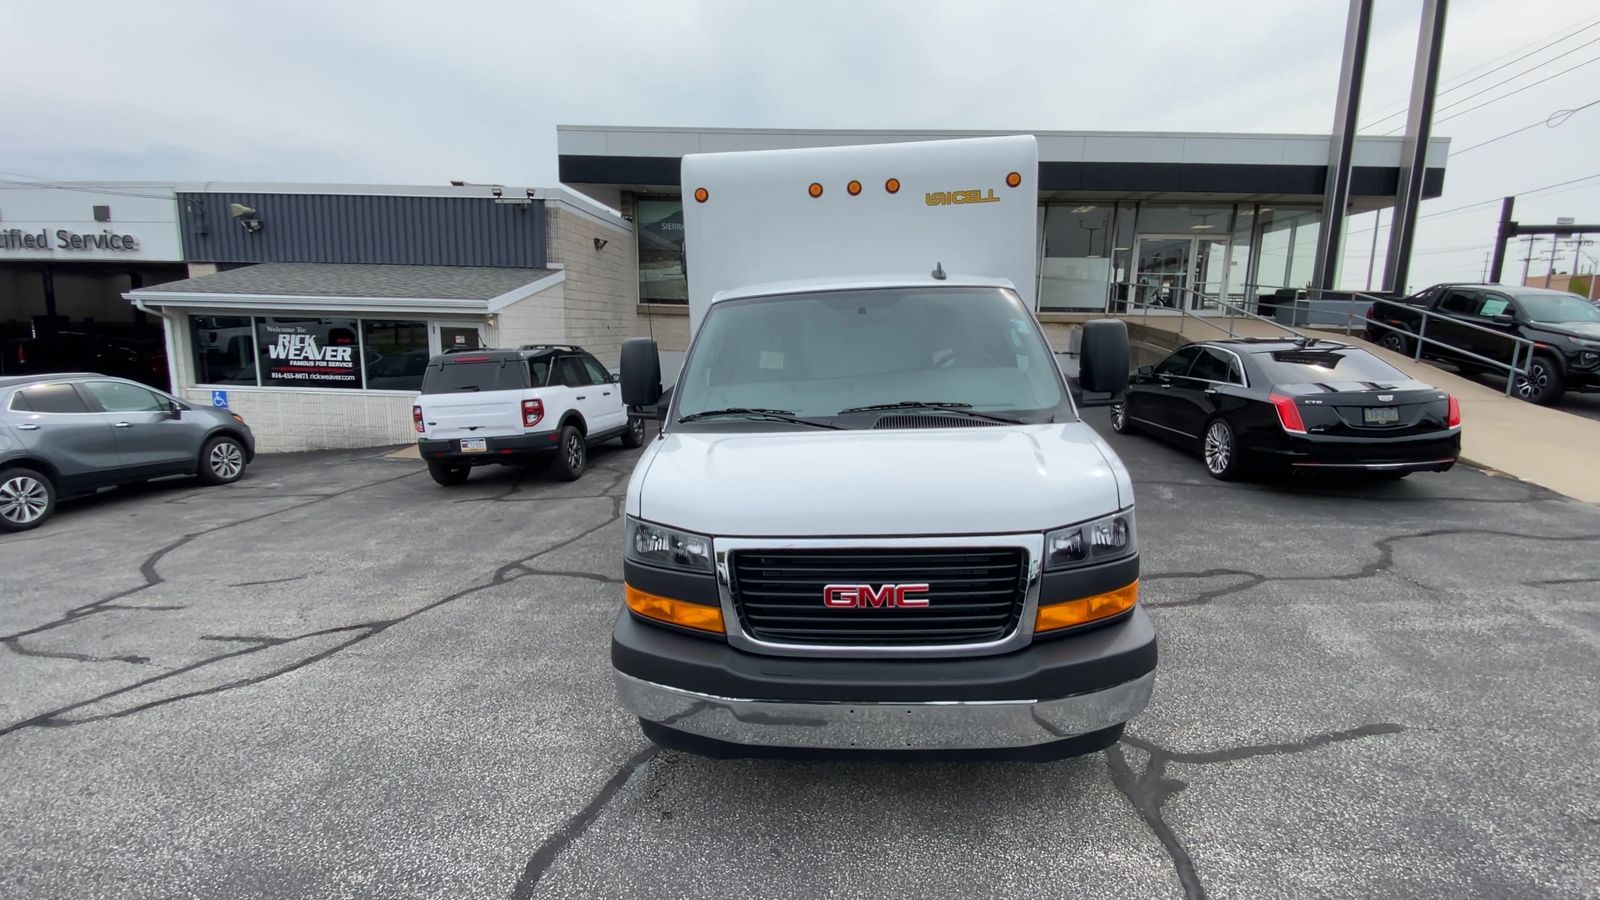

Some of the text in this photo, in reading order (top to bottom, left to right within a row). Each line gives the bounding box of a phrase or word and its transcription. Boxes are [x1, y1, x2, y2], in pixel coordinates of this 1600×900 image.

[56, 229, 136, 251] Service
[278, 334, 317, 347] RICK
[268, 344, 352, 361] WEAVER
[309, 373, 356, 381] rickweaver.com
[823, 583, 930, 609] GMC
